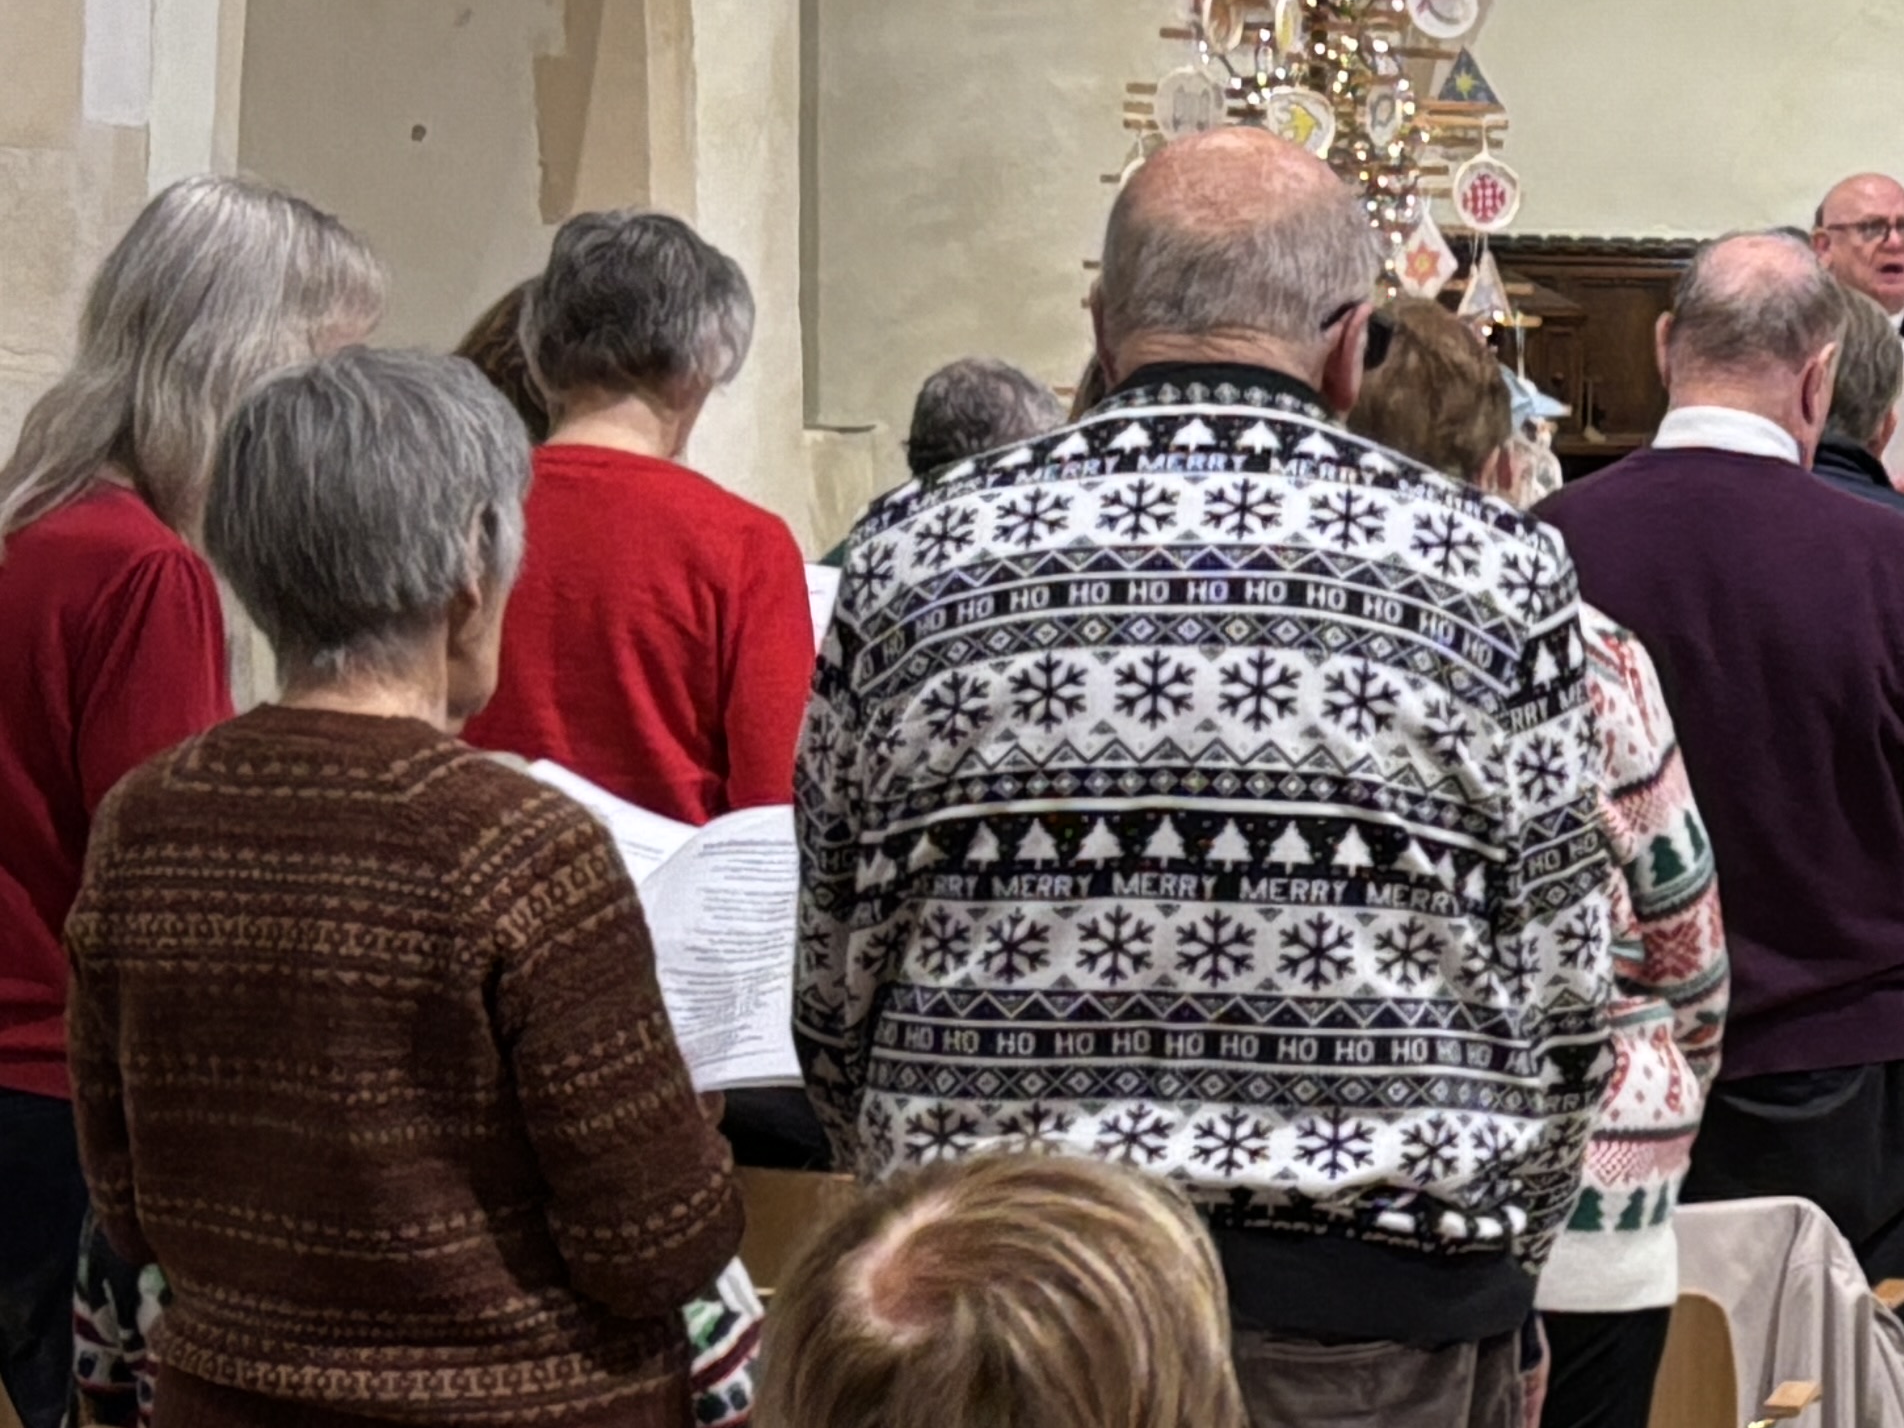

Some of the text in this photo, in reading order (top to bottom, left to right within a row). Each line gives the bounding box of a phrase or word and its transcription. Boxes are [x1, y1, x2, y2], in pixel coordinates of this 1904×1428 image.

[1137, 452, 1248, 473] MERRY
[914, 608, 948, 638] HO
[955, 595, 995, 624] HO
[1008, 585, 1051, 611] HO
[1068, 580, 1111, 604] HO
[1127, 579, 1170, 604] HO
[1186, 579, 1229, 603] HO
[1244, 579, 1288, 604] HO
[1306, 583, 1348, 611] HO
[1362, 595, 1403, 625] HO
[1418, 611, 1455, 647] HO
[1461, 632, 1494, 670] HO
[992, 873, 1093, 898] MERRY
[1111, 871, 1218, 900] MERRY
[1239, 877, 1349, 903] MERRY
[943, 1029, 981, 1054] HO
[996, 1031, 1037, 1056] HO
[1054, 1031, 1096, 1056] HO
[1111, 1029, 1152, 1055] HO
[1165, 1033, 1206, 1058] HO
[1219, 1034, 1260, 1058] HO
[1277, 1037, 1319, 1063] HO
[1334, 1038, 1375, 1063] HO
[1391, 1037, 1429, 1063] HO
